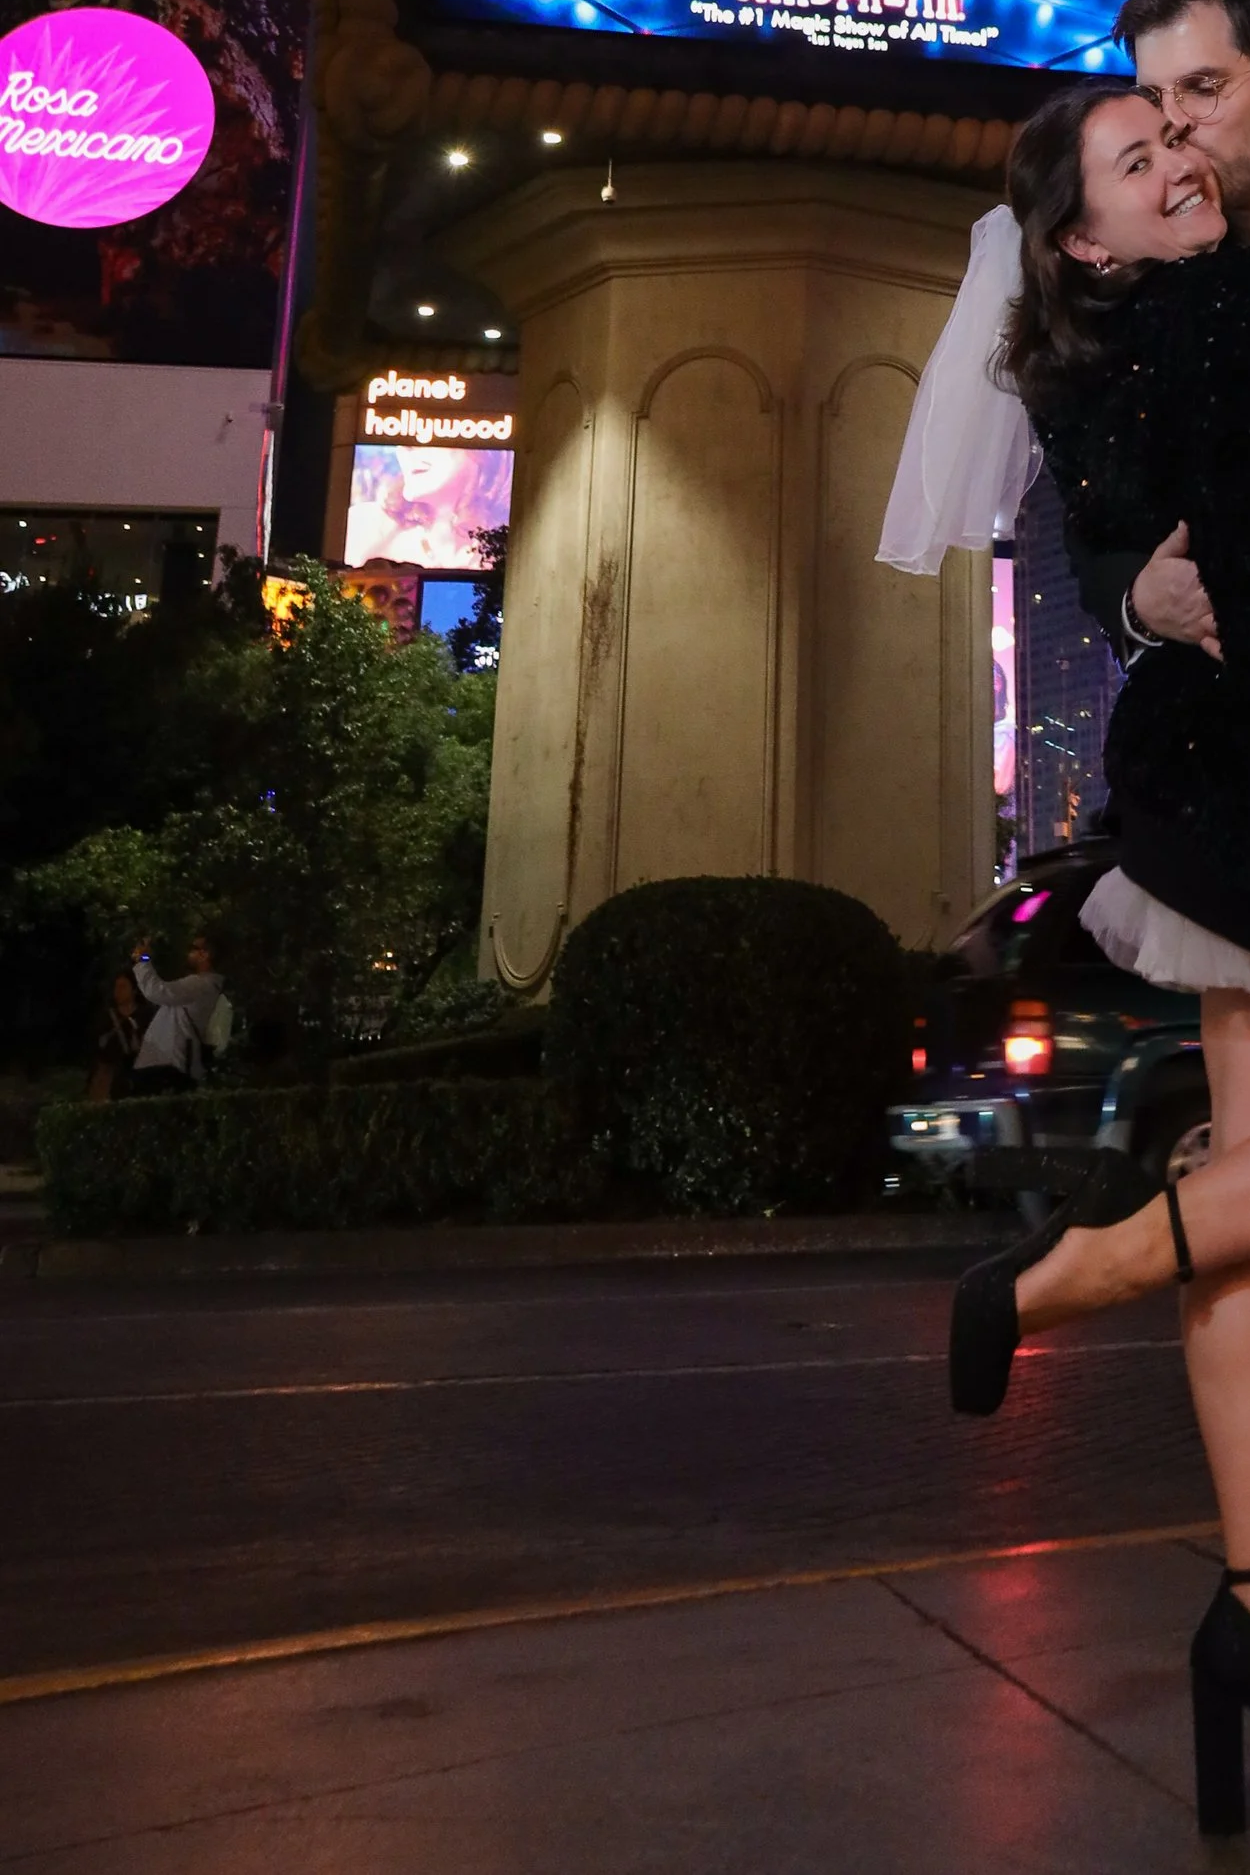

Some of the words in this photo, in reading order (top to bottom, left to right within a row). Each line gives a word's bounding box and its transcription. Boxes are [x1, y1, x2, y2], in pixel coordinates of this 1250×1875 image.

[738, 6, 765, 27] #1
[770, 10, 832, 37] Magic
[833, 14, 887, 39] Show
[887, 20, 910, 40] of
[909, 21, 938, 43] All
[0, 70, 99, 118] Rosa
[367, 370, 467, 404] planet
[364, 408, 513, 444] hollywood
